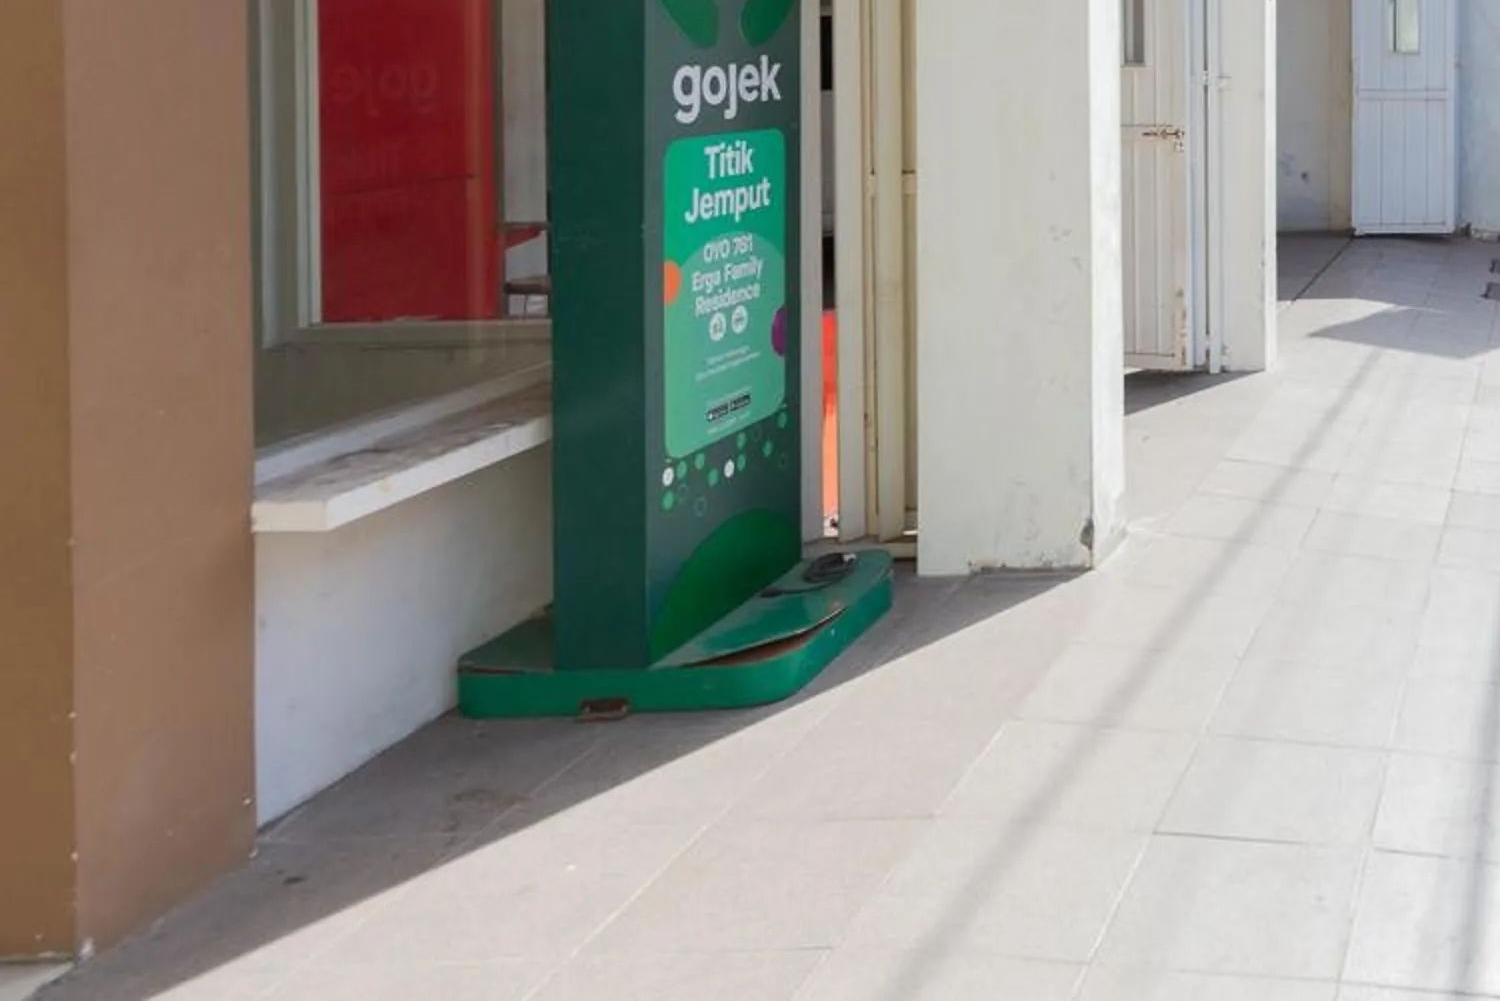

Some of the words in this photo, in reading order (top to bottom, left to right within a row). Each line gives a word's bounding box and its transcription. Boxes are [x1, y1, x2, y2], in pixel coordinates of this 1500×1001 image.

[673, 55, 782, 123] gojek
[704, 141, 754, 179] Titik
[684, 177, 771, 223] Jemput
[704, 239, 730, 263] OYO
[723, 256, 763, 284] Family
[695, 282, 761, 316] Residence
